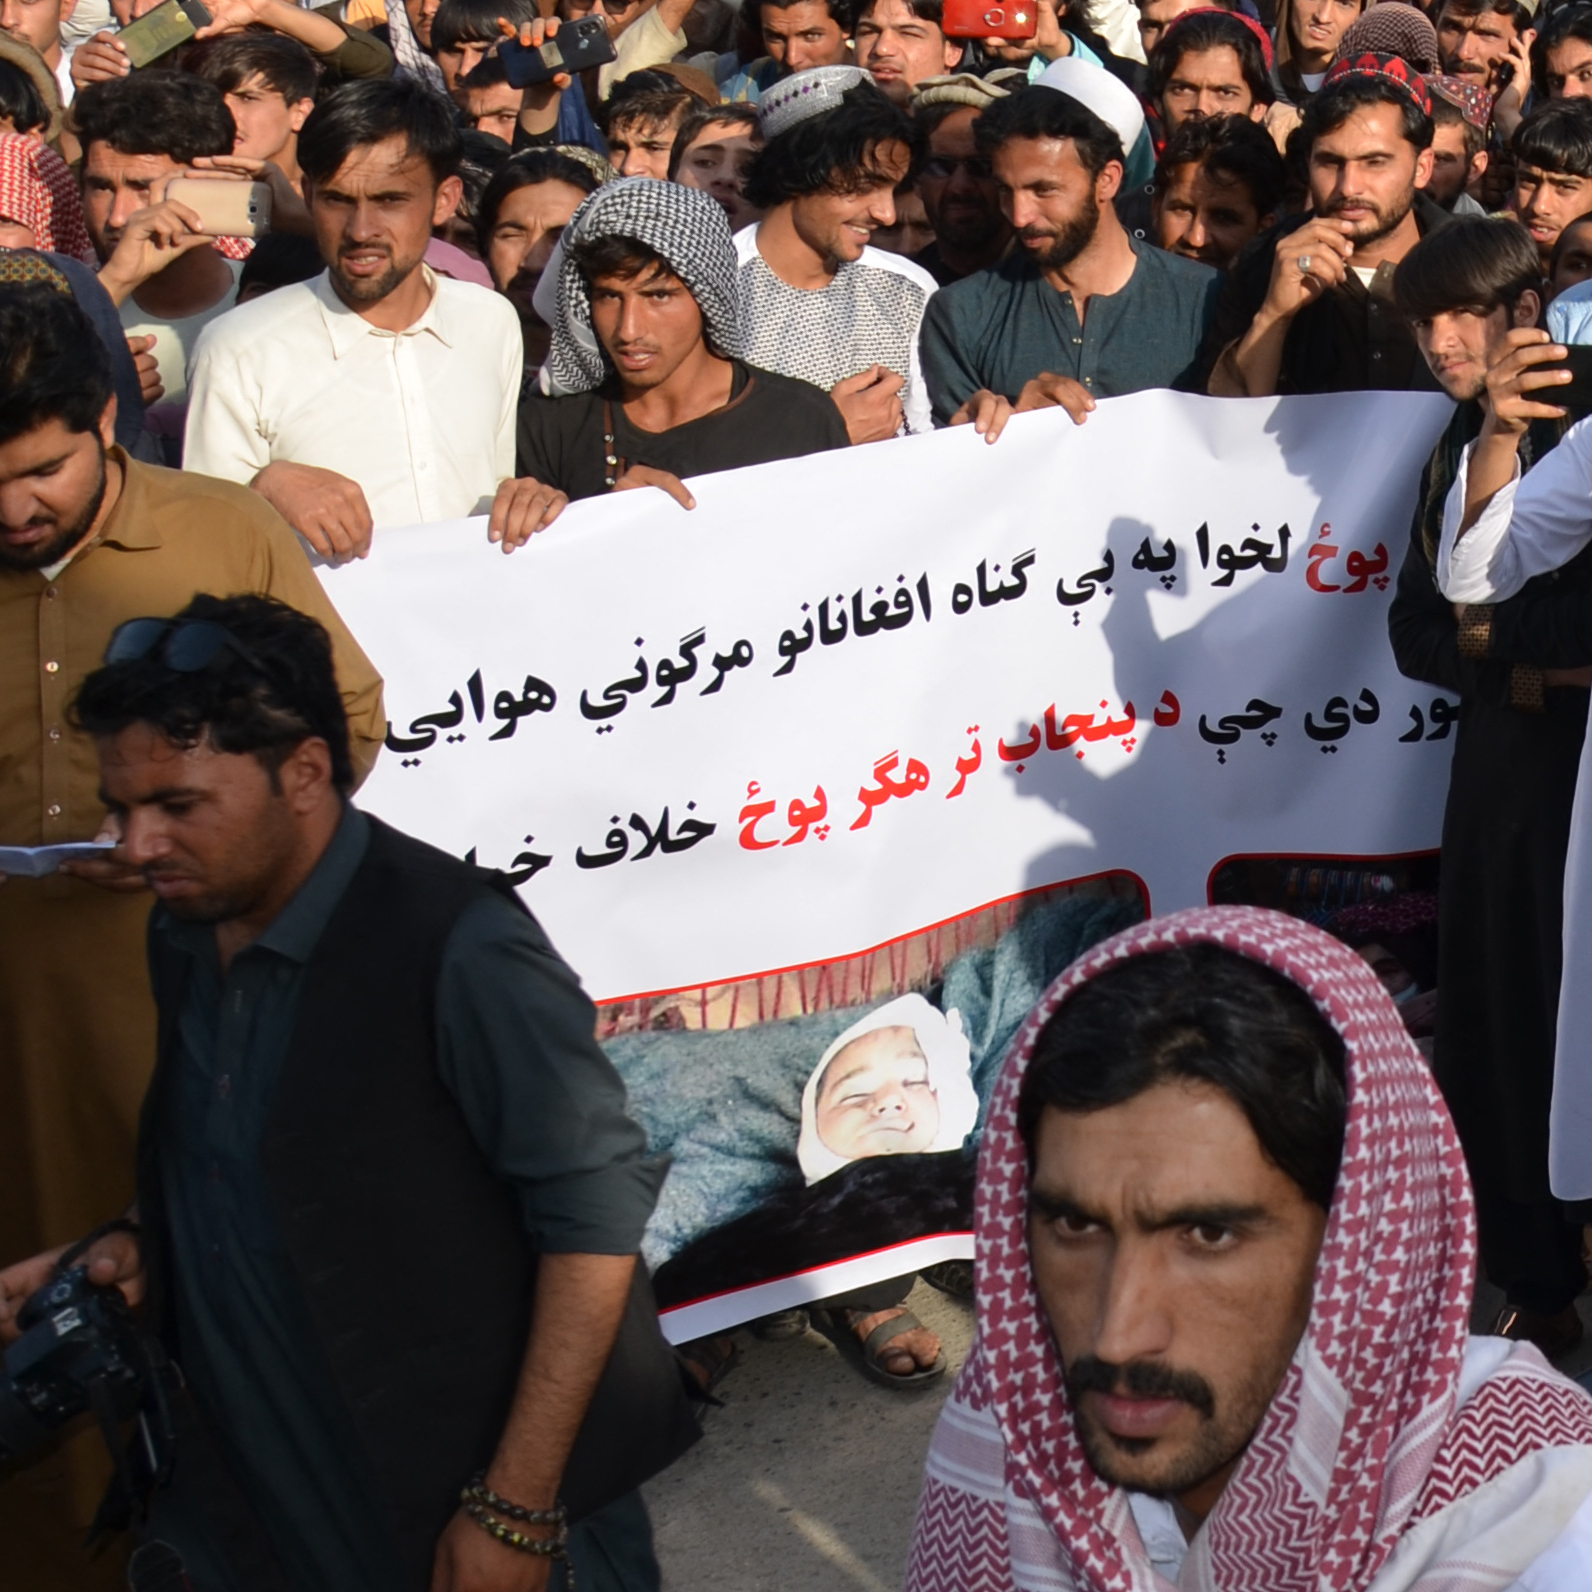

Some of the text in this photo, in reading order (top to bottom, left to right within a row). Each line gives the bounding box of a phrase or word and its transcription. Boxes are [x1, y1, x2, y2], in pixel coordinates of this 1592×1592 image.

[1055, 540, 1115, 627] بې
[1131, 532, 1178, 591] په
[1195, 521, 1292, 587] لخوا
[1304, 522, 1393, 594] پوځ
[772, 570, 933, 678] افغانانو
[997, 698, 1137, 775] پنجاب
[1153, 688, 1182, 728] د
[1197, 695, 1284, 766] چې
[1304, 687, 1382, 755] دي
[574, 798, 718, 870] خلاف
[737, 779, 831, 851] پوځ
